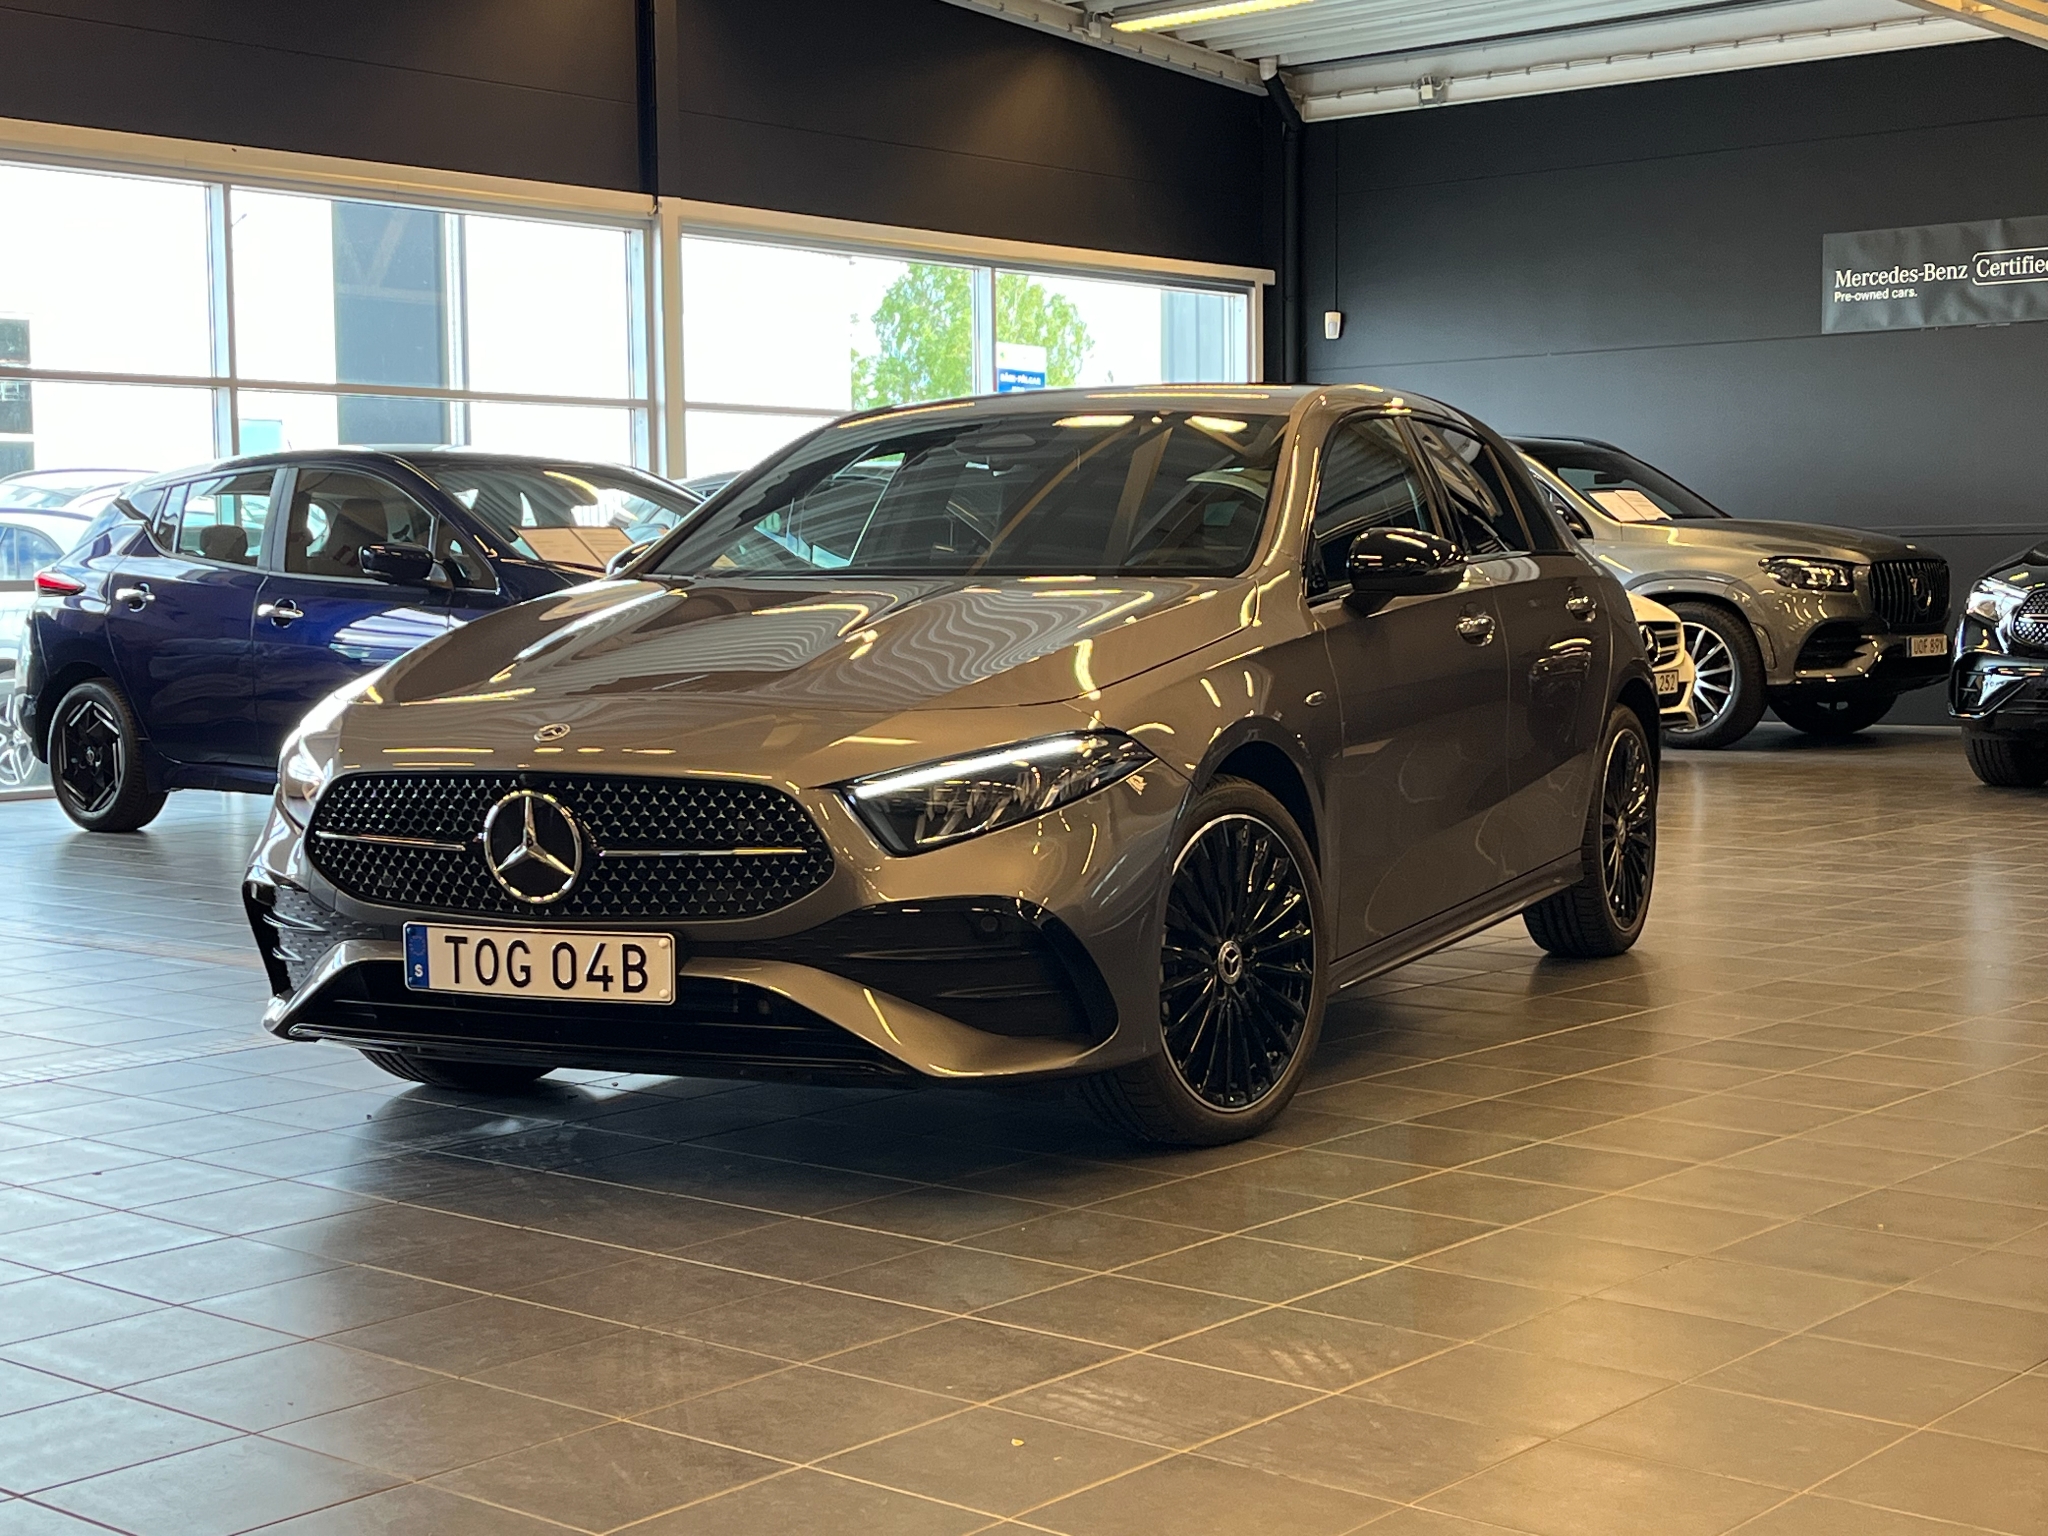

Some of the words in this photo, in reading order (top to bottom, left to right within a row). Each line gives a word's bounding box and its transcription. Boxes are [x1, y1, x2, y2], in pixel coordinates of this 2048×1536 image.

[1834, 263, 1968, 289] Mercedes-Benz
[1834, 287, 1890, 302] Pre-owned
[1891, 288, 1918, 299] cars.
[1659, 674, 1676, 692] 252
[414, 963, 424, 977] S
[444, 935, 532, 988] TOG
[551, 941, 649, 994] 04B
